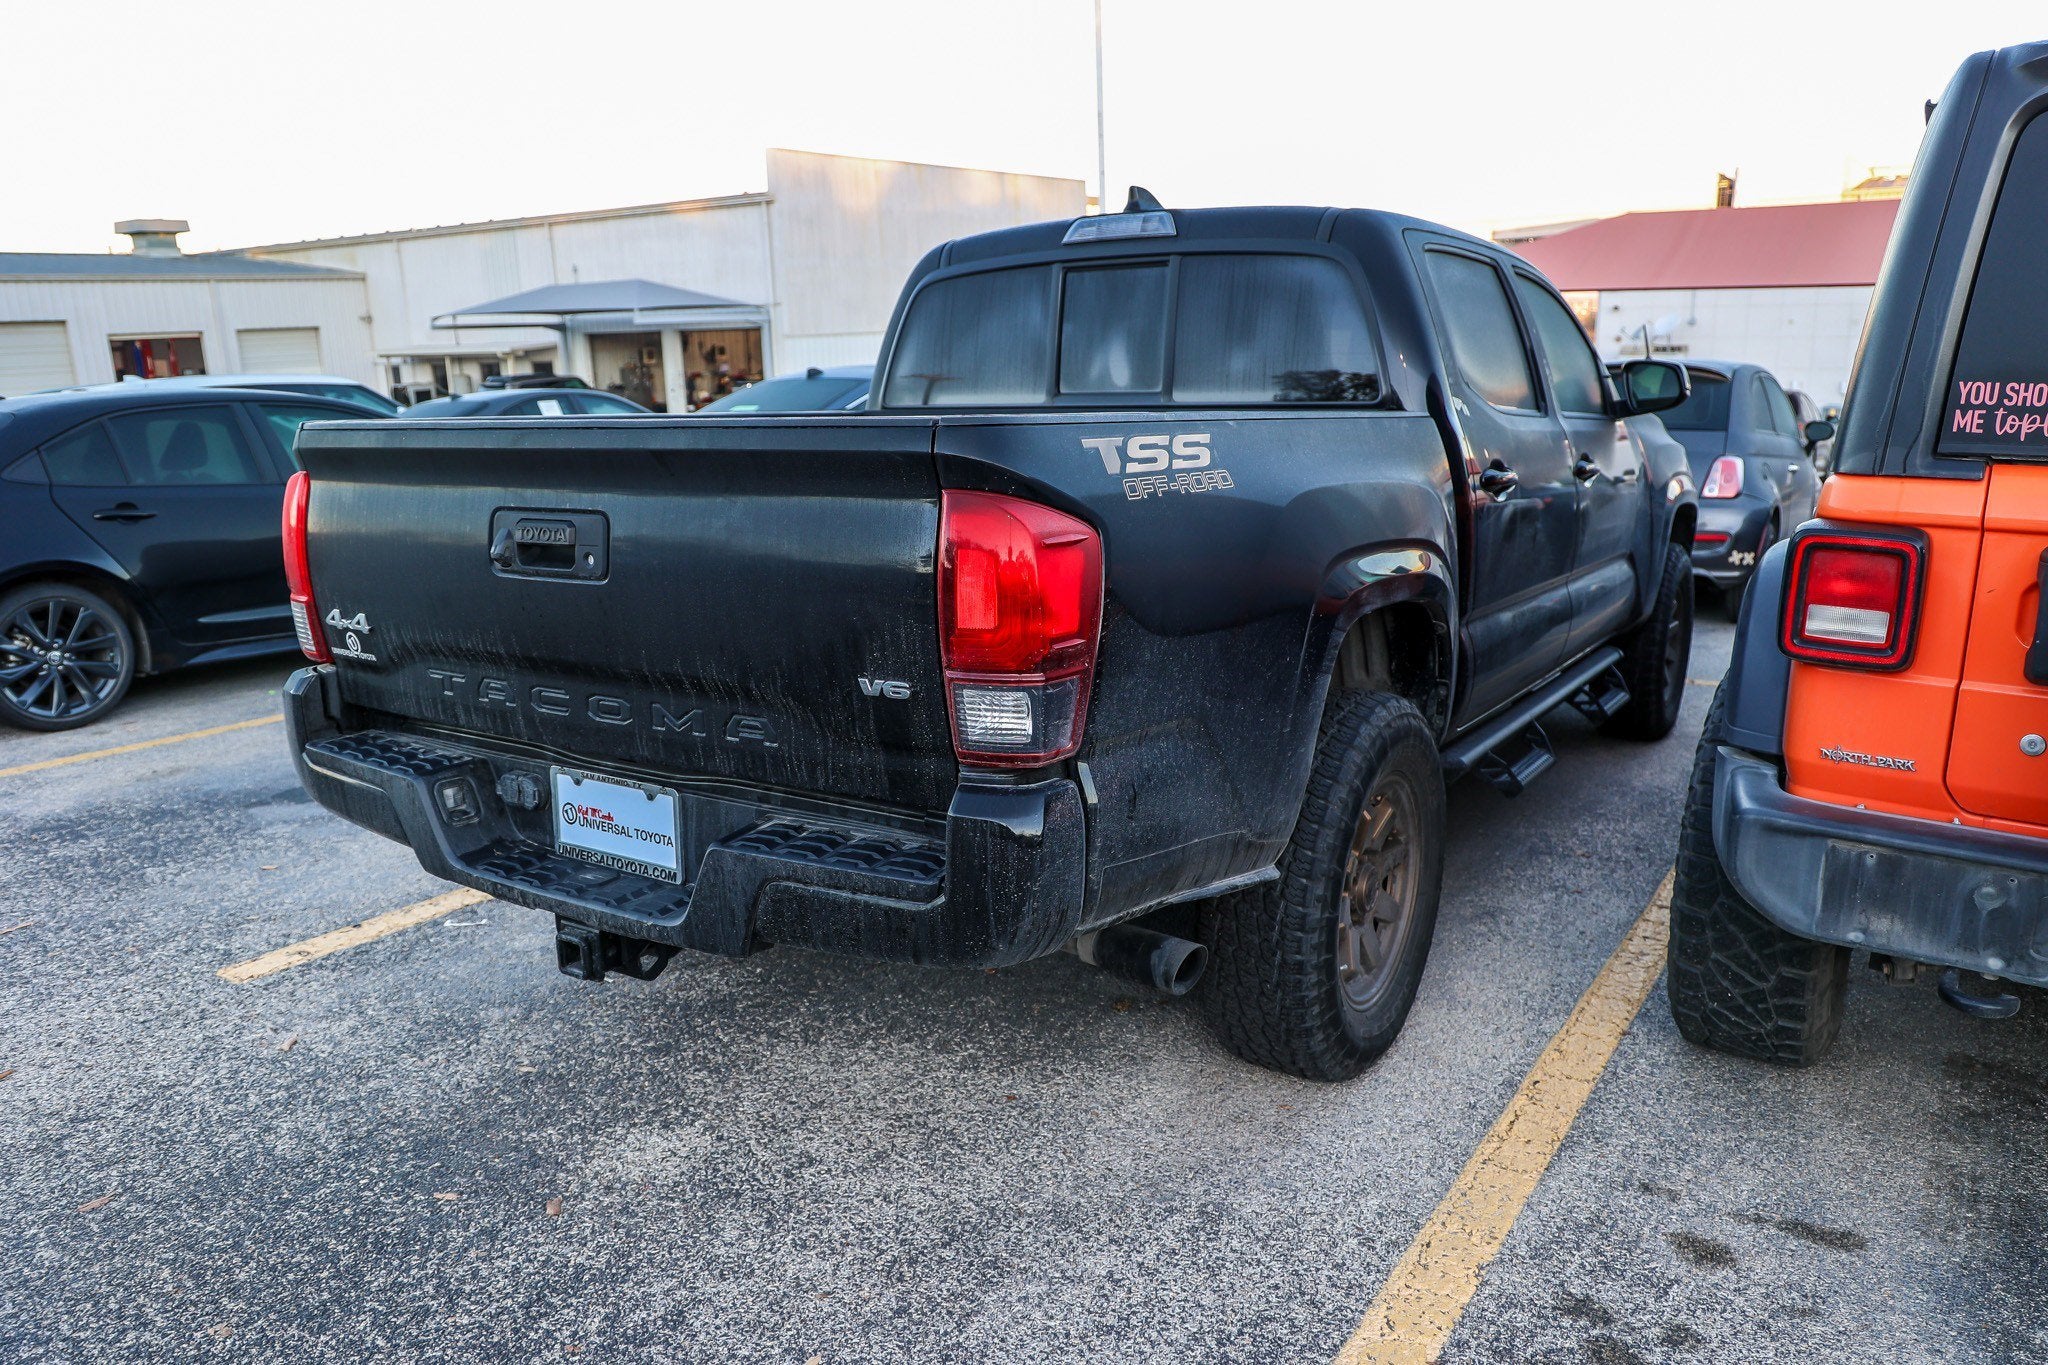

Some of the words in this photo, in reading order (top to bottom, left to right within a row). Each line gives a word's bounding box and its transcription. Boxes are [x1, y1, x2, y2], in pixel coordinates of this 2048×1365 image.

[1959, 381, 2000, 405] YOU
[1952, 409, 1986, 433] ME
[1081, 433, 1211, 475] TSS
[1123, 469, 1234, 501] OFF-ROAD
[517, 526, 568, 542] TOYOTA
[857, 677, 910, 700] V6
[428, 668, 780, 748] TACOMA
[580, 771, 596, 782] SAN
[630, 780, 643, 789] TX
[578, 815, 633, 838] UNIVERSAL
[633, 828, 674, 848] TOYOTA
[558, 844, 677, 882] UNIVERSALTOYOTA.COM
